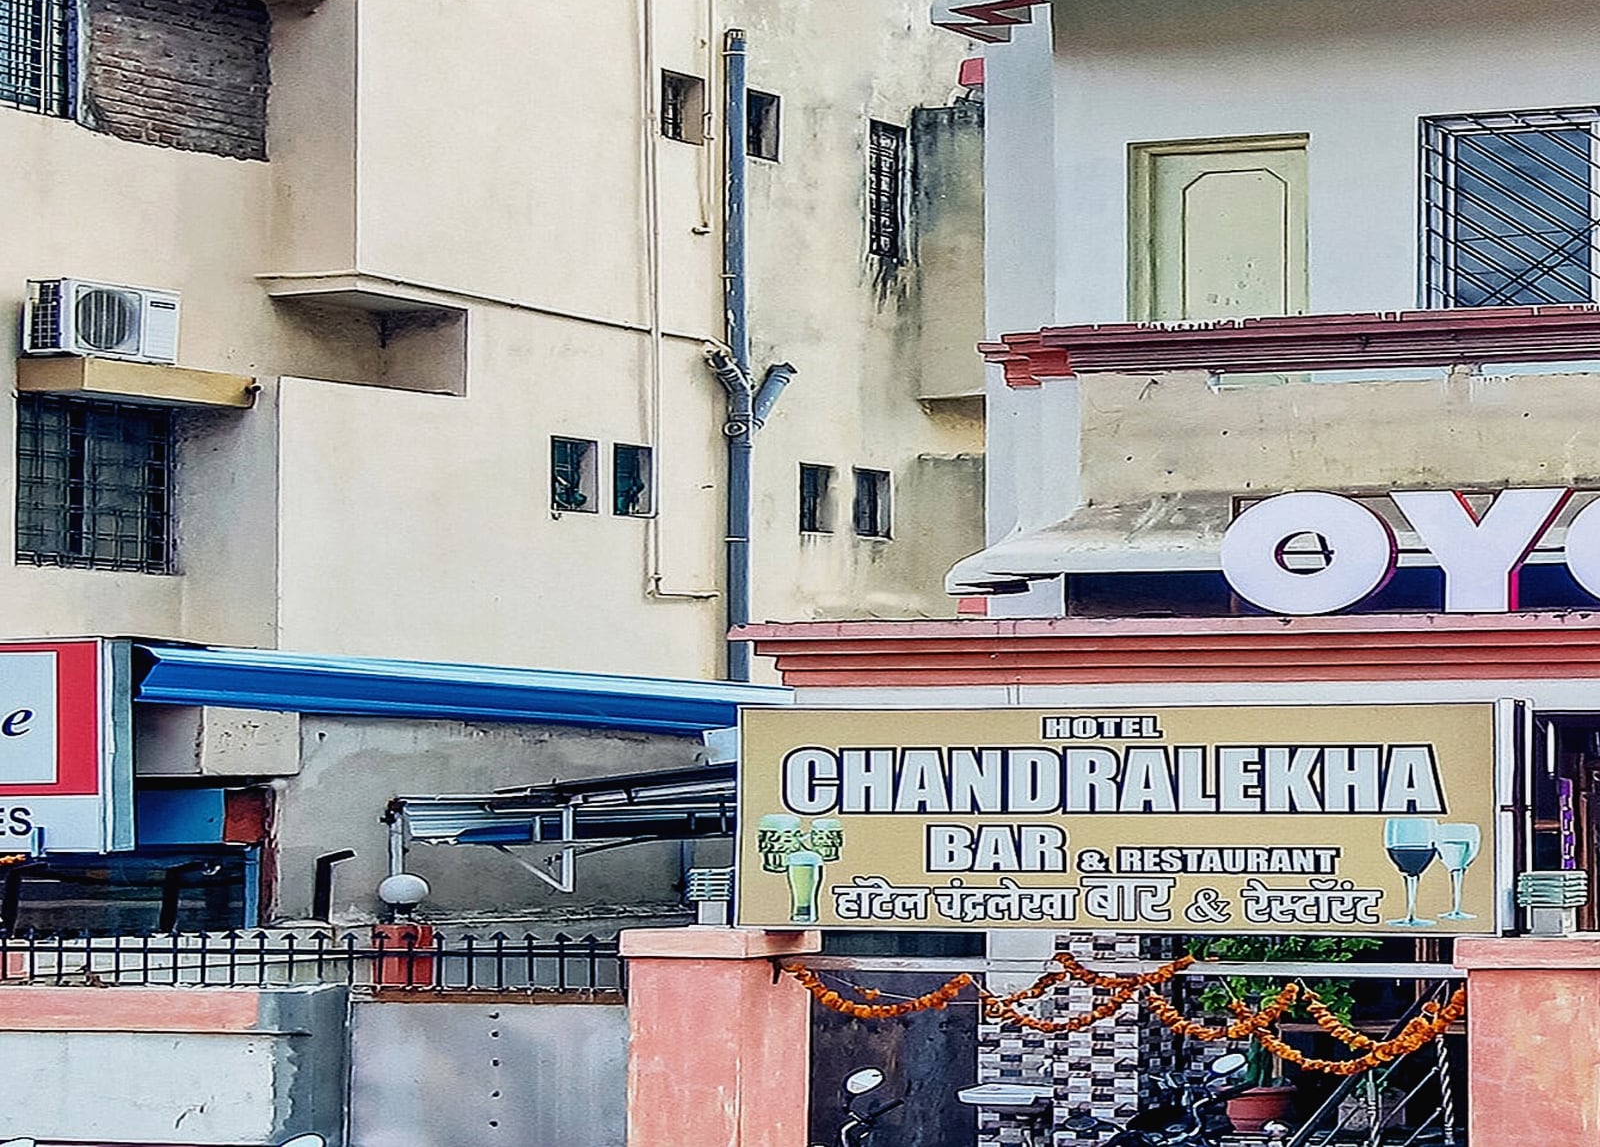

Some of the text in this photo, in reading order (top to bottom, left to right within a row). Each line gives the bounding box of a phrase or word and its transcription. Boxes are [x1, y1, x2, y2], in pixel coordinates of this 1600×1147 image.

[1041, 716, 1163, 740] HOTEL
[782, 744, 1447, 815] CHANDRALEKHA
[925, 825, 1340, 874] BAR & RESTAURANT
[1080, 876, 1176, 922] बार
[1184, 887, 1232, 923] &
